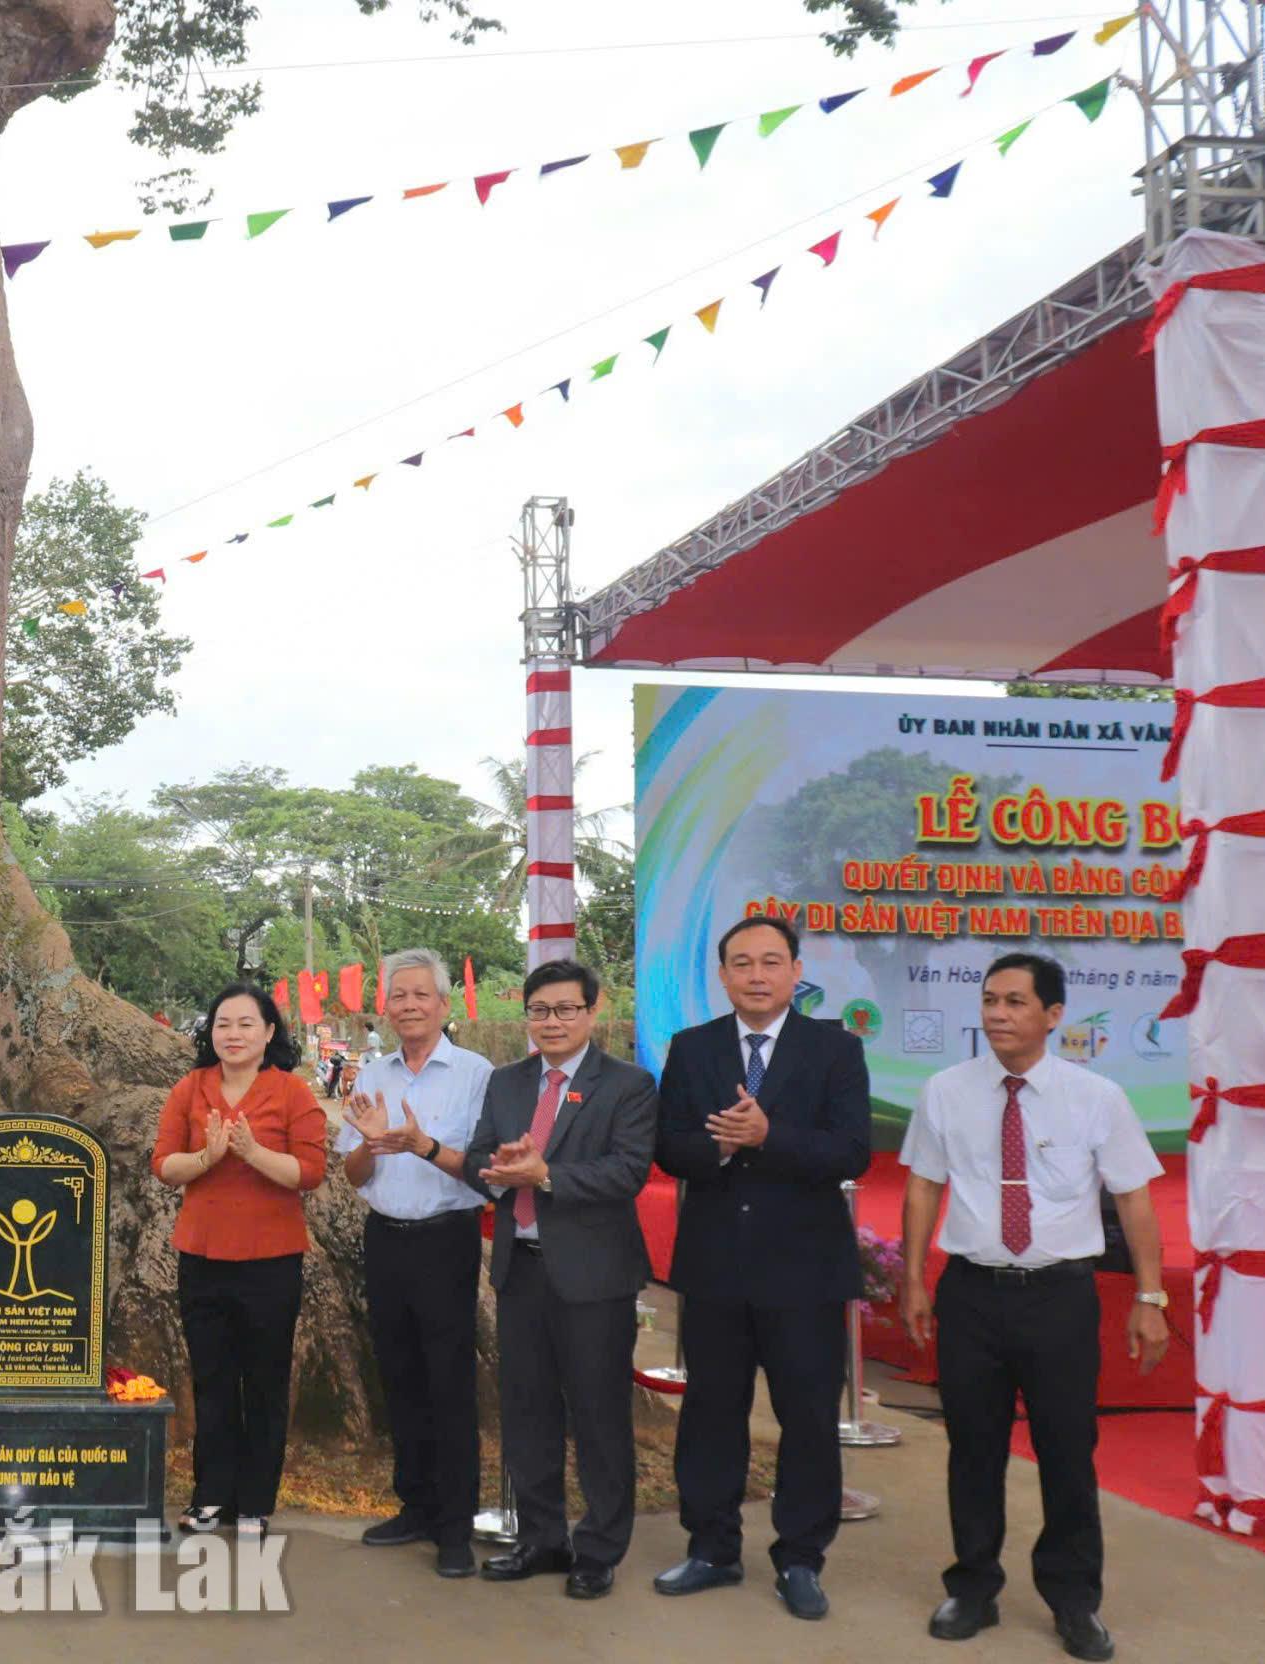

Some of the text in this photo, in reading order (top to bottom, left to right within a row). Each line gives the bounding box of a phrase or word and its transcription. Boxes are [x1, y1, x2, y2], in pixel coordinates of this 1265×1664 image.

[899, 713, 926, 734] ỦY
[934, 718, 975, 736] BAN
[984, 718, 1040, 738] NHÂN
[1048, 720, 1090, 740] DÂN
[1131, 723, 1173, 742] VÂN
[916, 774, 1183, 847] LỄ CÔNG B
[843, 853, 932, 892] QUYẾT
[937, 863, 1004, 897] ĐỊNH
[1009, 857, 1047, 894] VÀ
[1131, 863, 1185, 897] CÔN
[806, 903, 834, 932] DI
[841, 895, 898, 933] SẢN
[903, 899, 963, 940] VIỆT
[969, 905, 1030, 936] NAM
[1035, 902, 1105, 937] TRÊN
[1110, 909, 1159, 943] ĐỊA
[1163, 909, 1184, 938] B
[908, 965, 1178, 989] Vân Hòa tháng 8 năm
[4, 1304, 25, 1316] SẢN
[28, 1306, 51, 1317] VIỆT
[53, 1307, 77, 1316] NAM
[10, 1318, 50, 1326] HERITAGE
[25, 1341, 50, 1353] (CÂY
[52, 1342, 74, 1353] SUI)
[38, 1446, 55, 1463] GIÁ
[57, 1445, 78, 1463] CỦA
[80, 1445, 107, 1463] QUỐC
[110, 1448, 127, 1463] GIA
[20, 1471, 37, 1486] TAY
[39, 1468, 60, 1486] BẢO
[62, 1469, 75, 1488] VỆ
